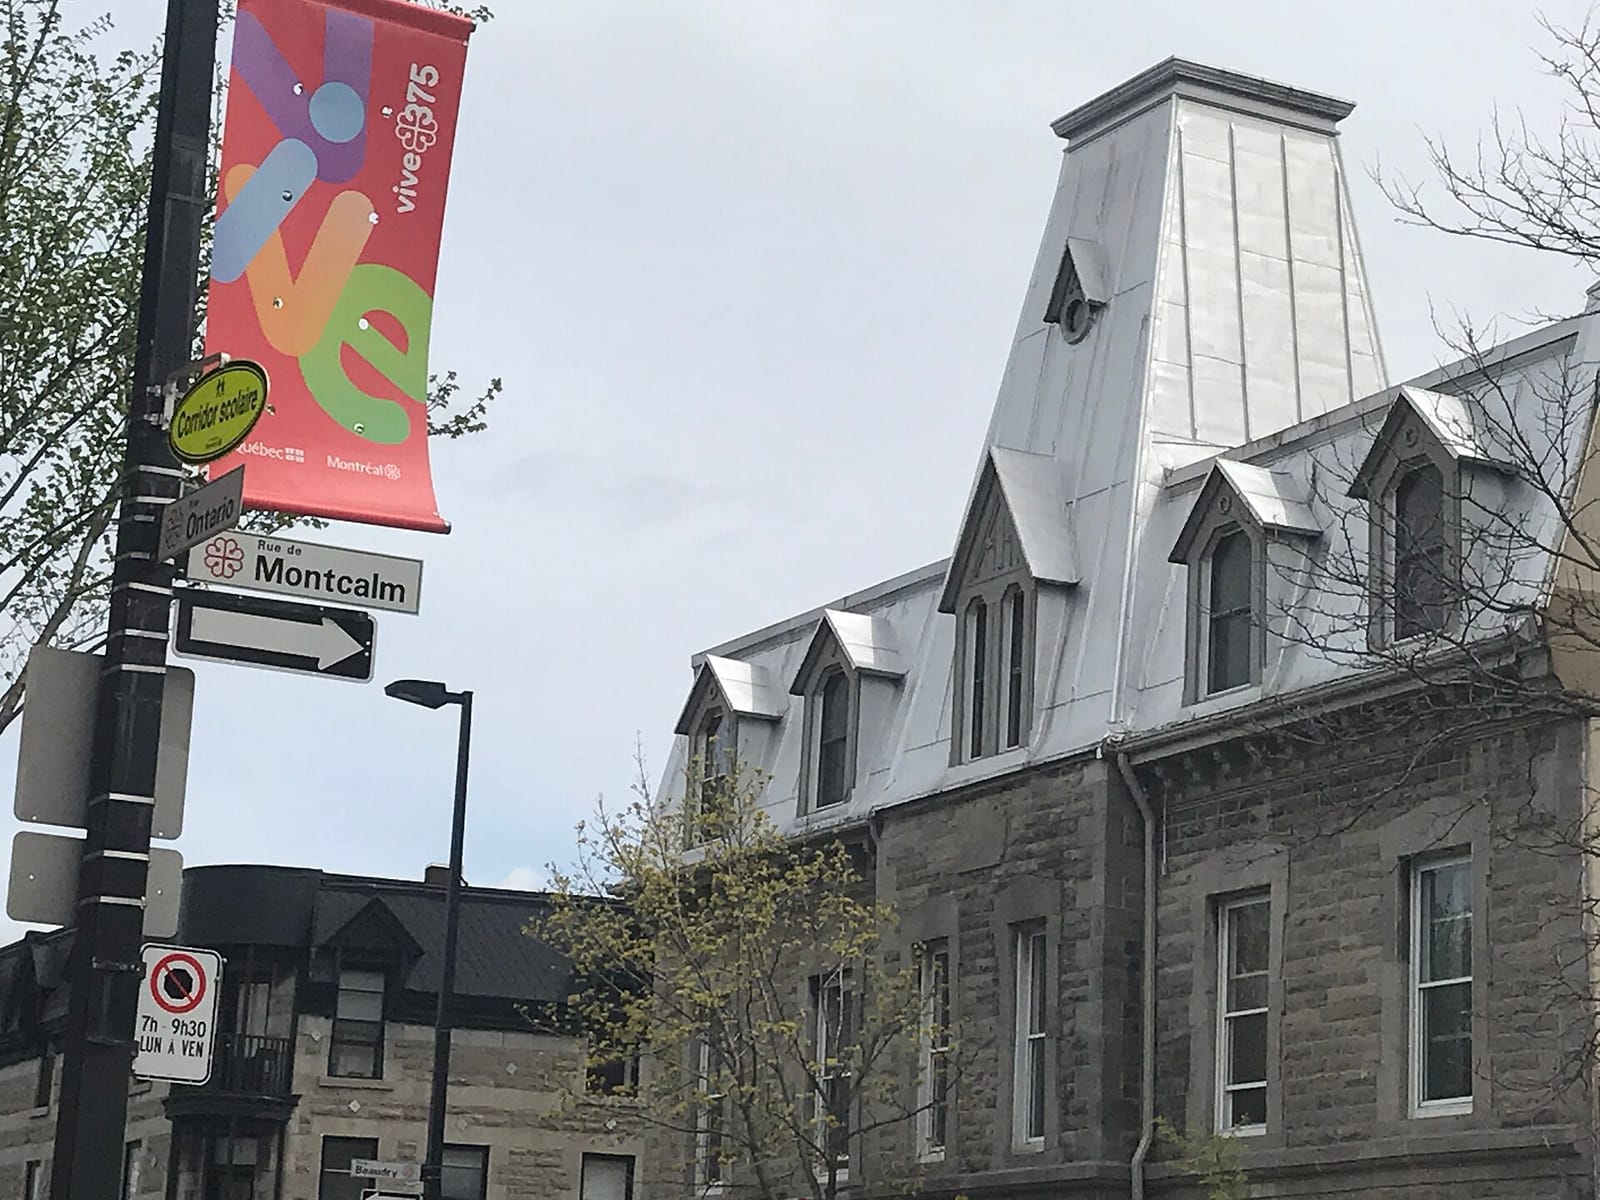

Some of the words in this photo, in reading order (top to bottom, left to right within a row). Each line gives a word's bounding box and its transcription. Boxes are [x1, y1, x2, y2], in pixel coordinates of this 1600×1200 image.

[178, 402, 218, 438] Corridor
[219, 387, 258, 423] scolaire
[327, 455, 384, 477] Montréal
[186, 496, 234, 539] Ontario
[258, 539, 282, 553] Rue
[287, 544, 302, 556] de
[255, 554, 406, 603] Montcalm
[141, 1015, 158, 1032] 7h
[172, 1018, 206, 1038] 9h30
[140, 1035, 162, 1053] LUN
[182, 1039, 204, 1058] VEN
[355, 1165, 398, 1178] Beaudry
